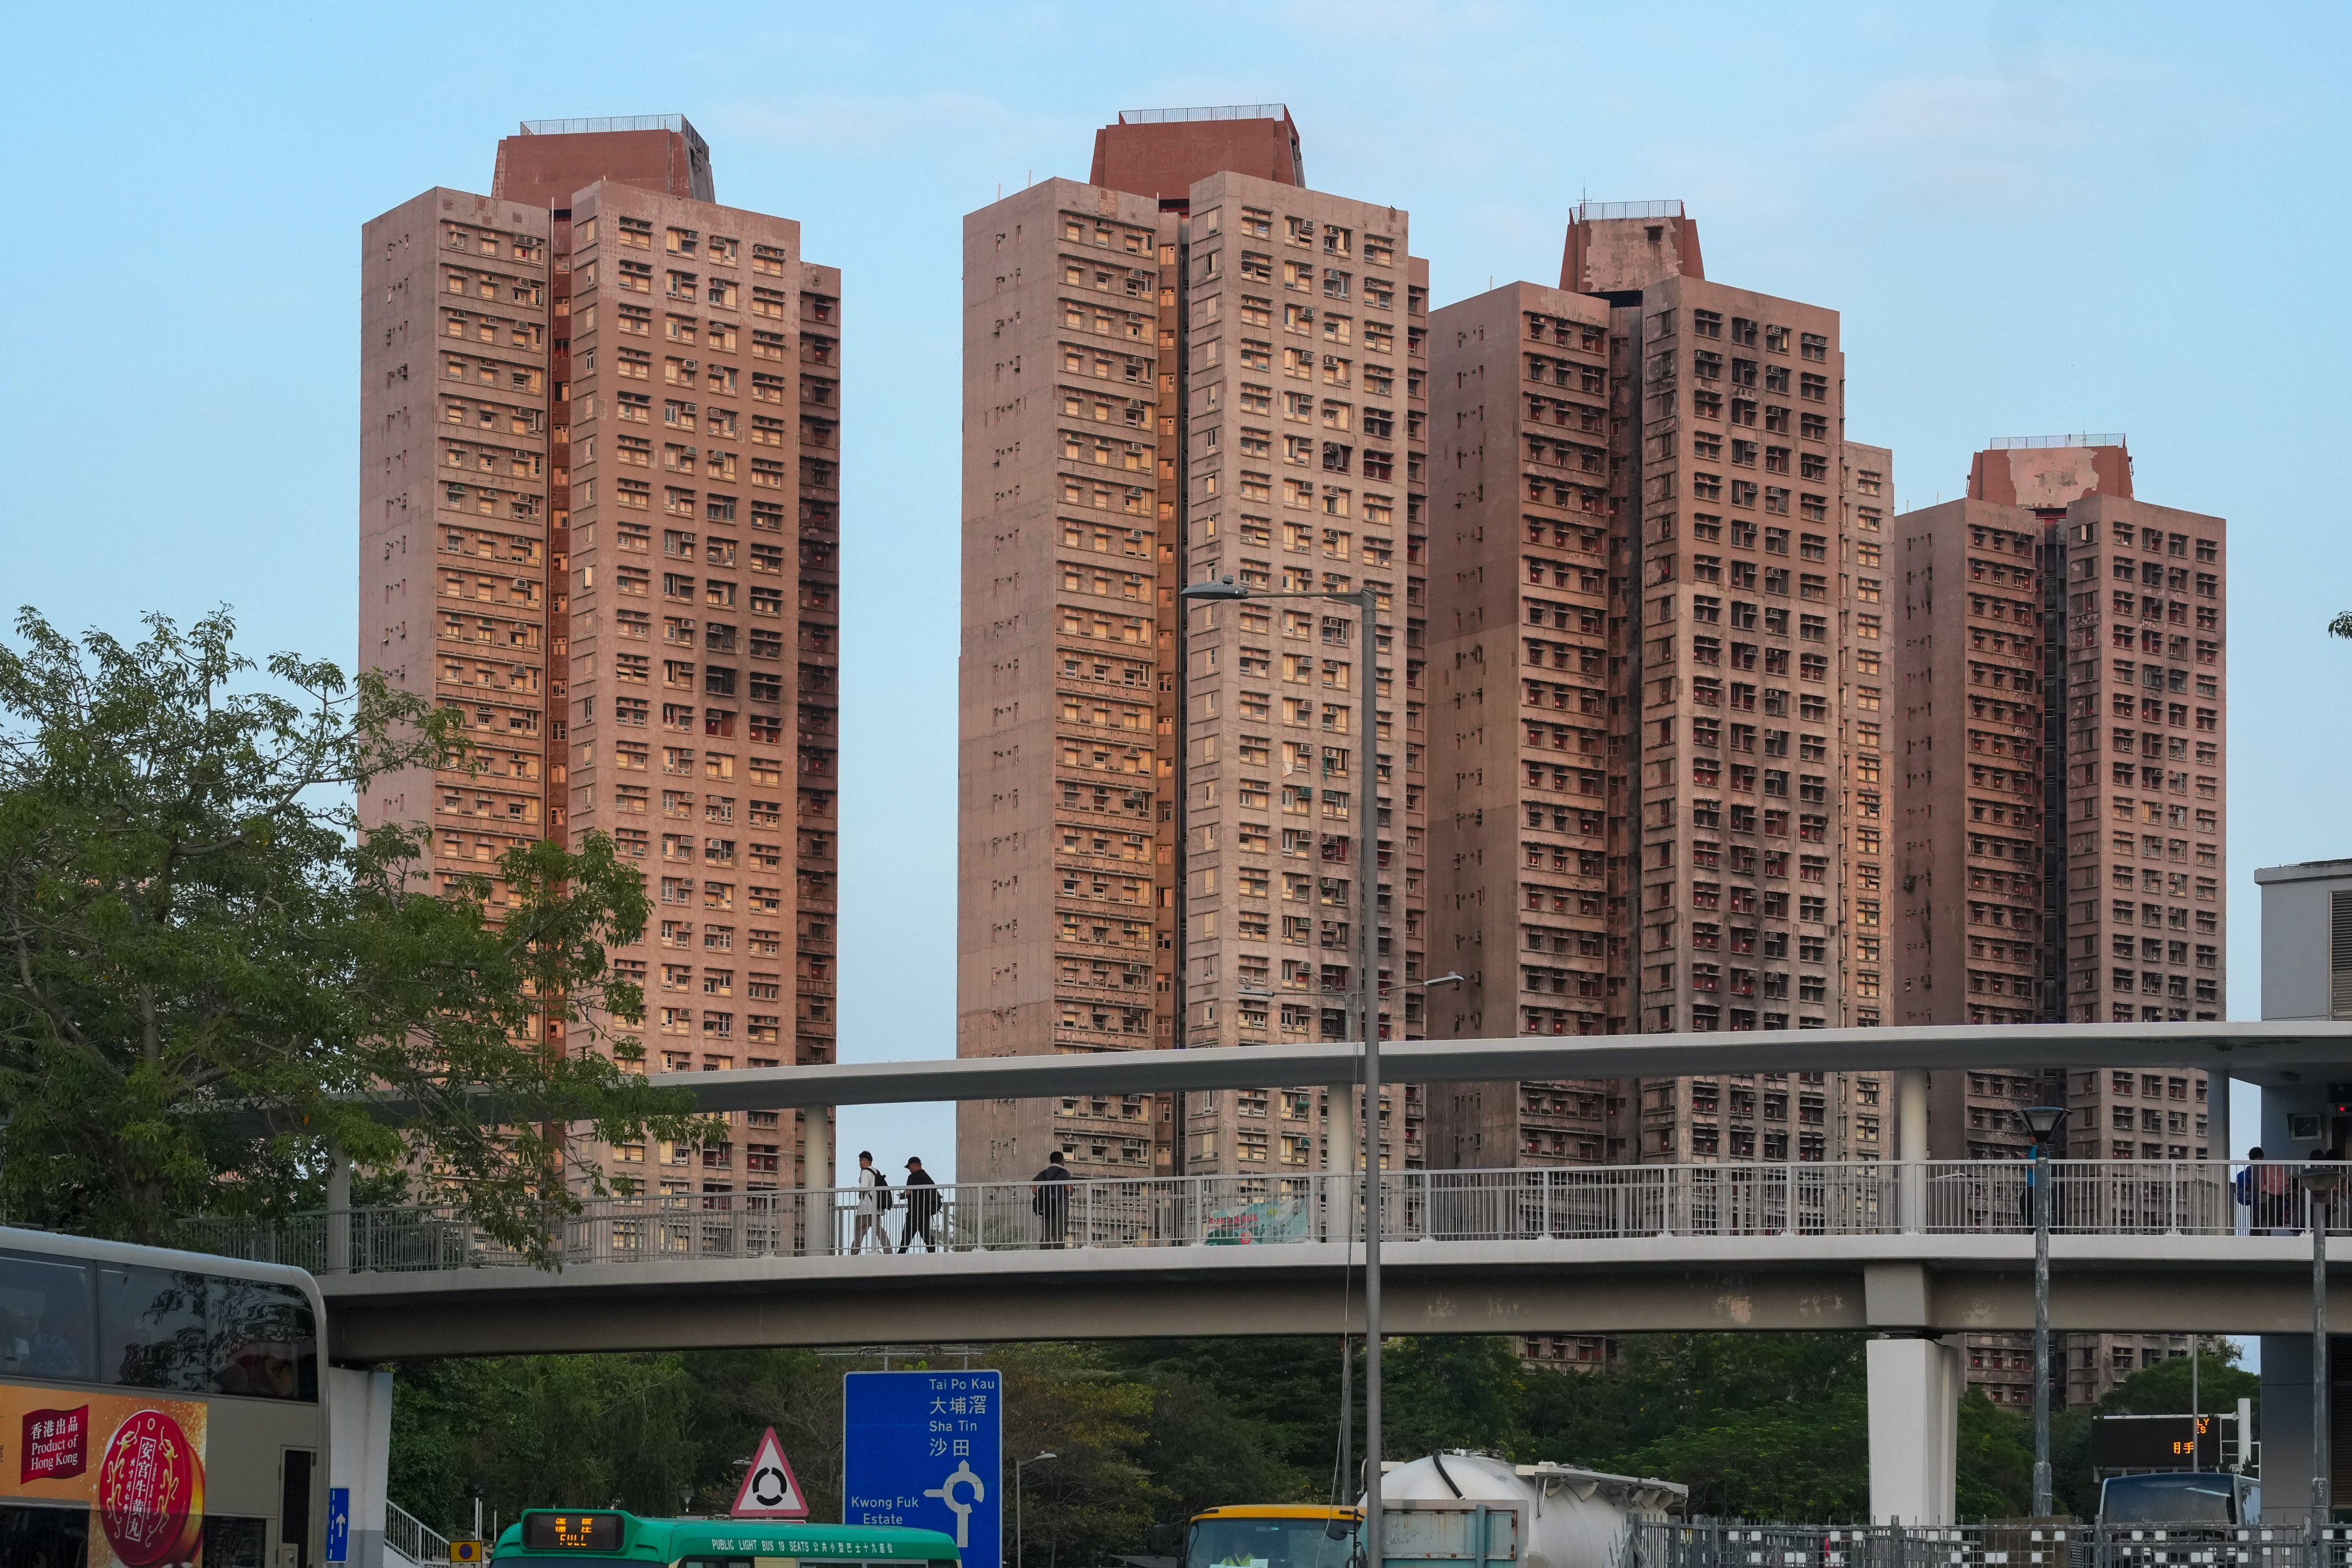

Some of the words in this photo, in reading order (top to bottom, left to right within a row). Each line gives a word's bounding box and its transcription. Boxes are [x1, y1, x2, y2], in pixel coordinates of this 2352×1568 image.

[929, 1378, 947, 1390] Tai
[951, 1378, 966, 1390] Po
[972, 1378, 994, 1389] Kau
[929, 1395, 986, 1415] 大埔滘
[30, 1416, 78, 1440] 香港出品
[929, 1420, 952, 1431] Sha
[958, 1420, 977, 1431] Tin
[31, 1439, 65, 1455] Product
[68, 1434, 78, 1449] of
[929, 1438, 969, 1457] 沙田
[30, 1457, 53, 1470] Hong
[56, 1452, 78, 1466] Kong
[852, 1496, 892, 1509] Kwong
[897, 1496, 918, 1508] Fuk
[863, 1513, 903, 1524] Estate
[560, 1534, 586, 1546] FULL
[712, 1539, 735, 1550] PUBLIC
[739, 1539, 756, 1551] LIGHT
[762, 1540, 774, 1551] BUS
[778, 1540, 785, 1551] 19
[789, 1541, 809, 1552] SEATS
[813, 1541, 893, 1553] 公共小型巴士十九座位
